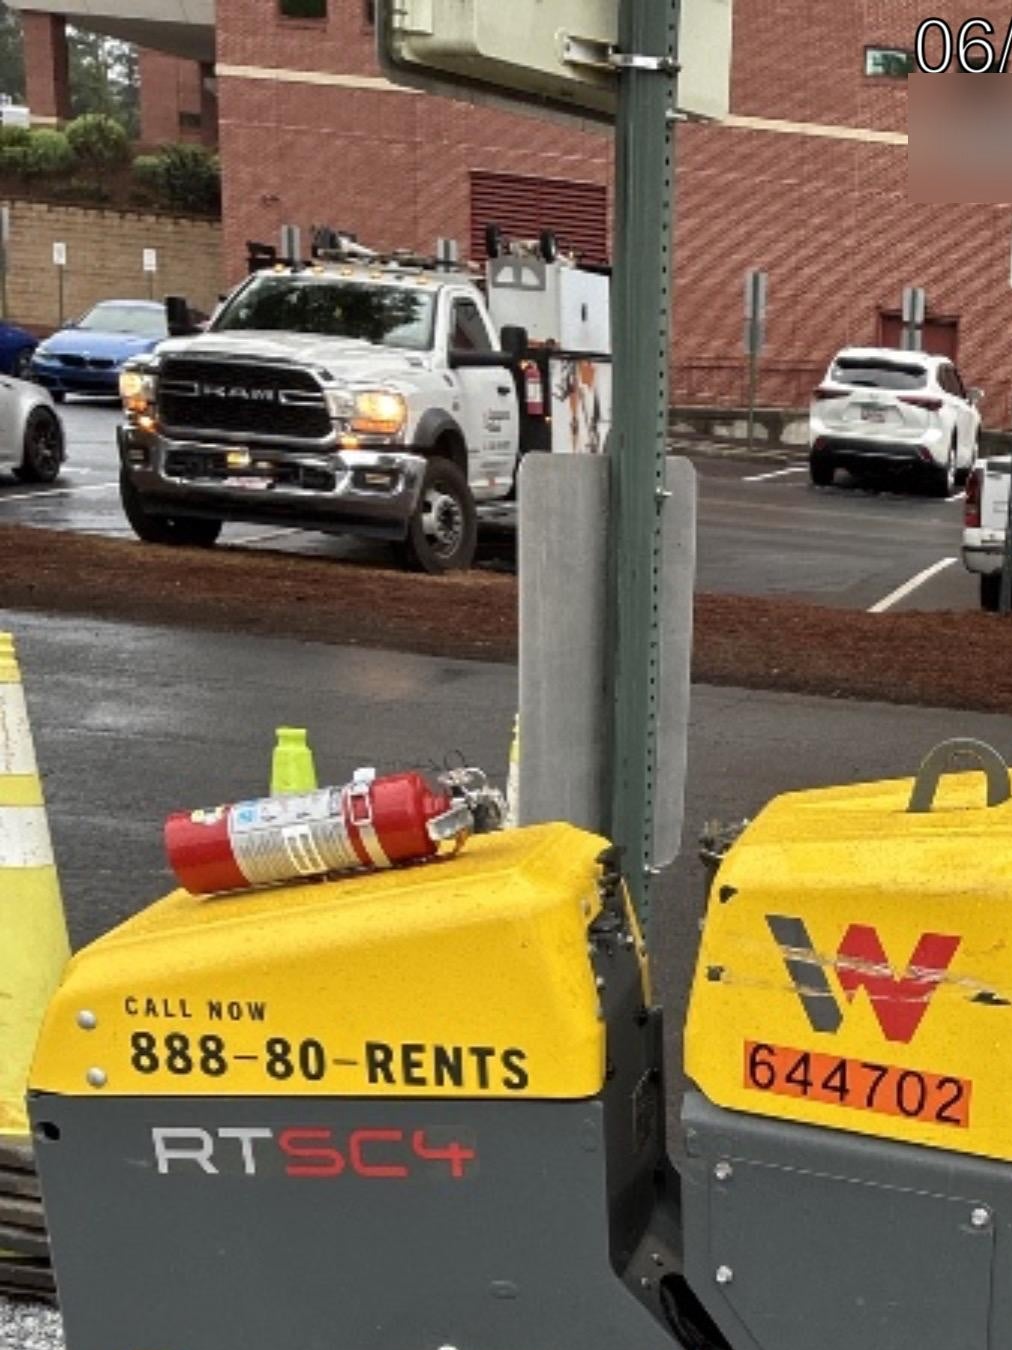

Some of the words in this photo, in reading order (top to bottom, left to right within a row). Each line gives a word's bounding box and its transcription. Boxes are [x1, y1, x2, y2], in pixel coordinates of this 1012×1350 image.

[124, 996, 193, 1018] CALL
[208, 1000, 267, 1021] NOW
[131, 1031, 529, 1090] 888-80-RENTS
[749, 1043, 964, 1125] 644702
[151, 1127, 475, 1178] RTSC4
